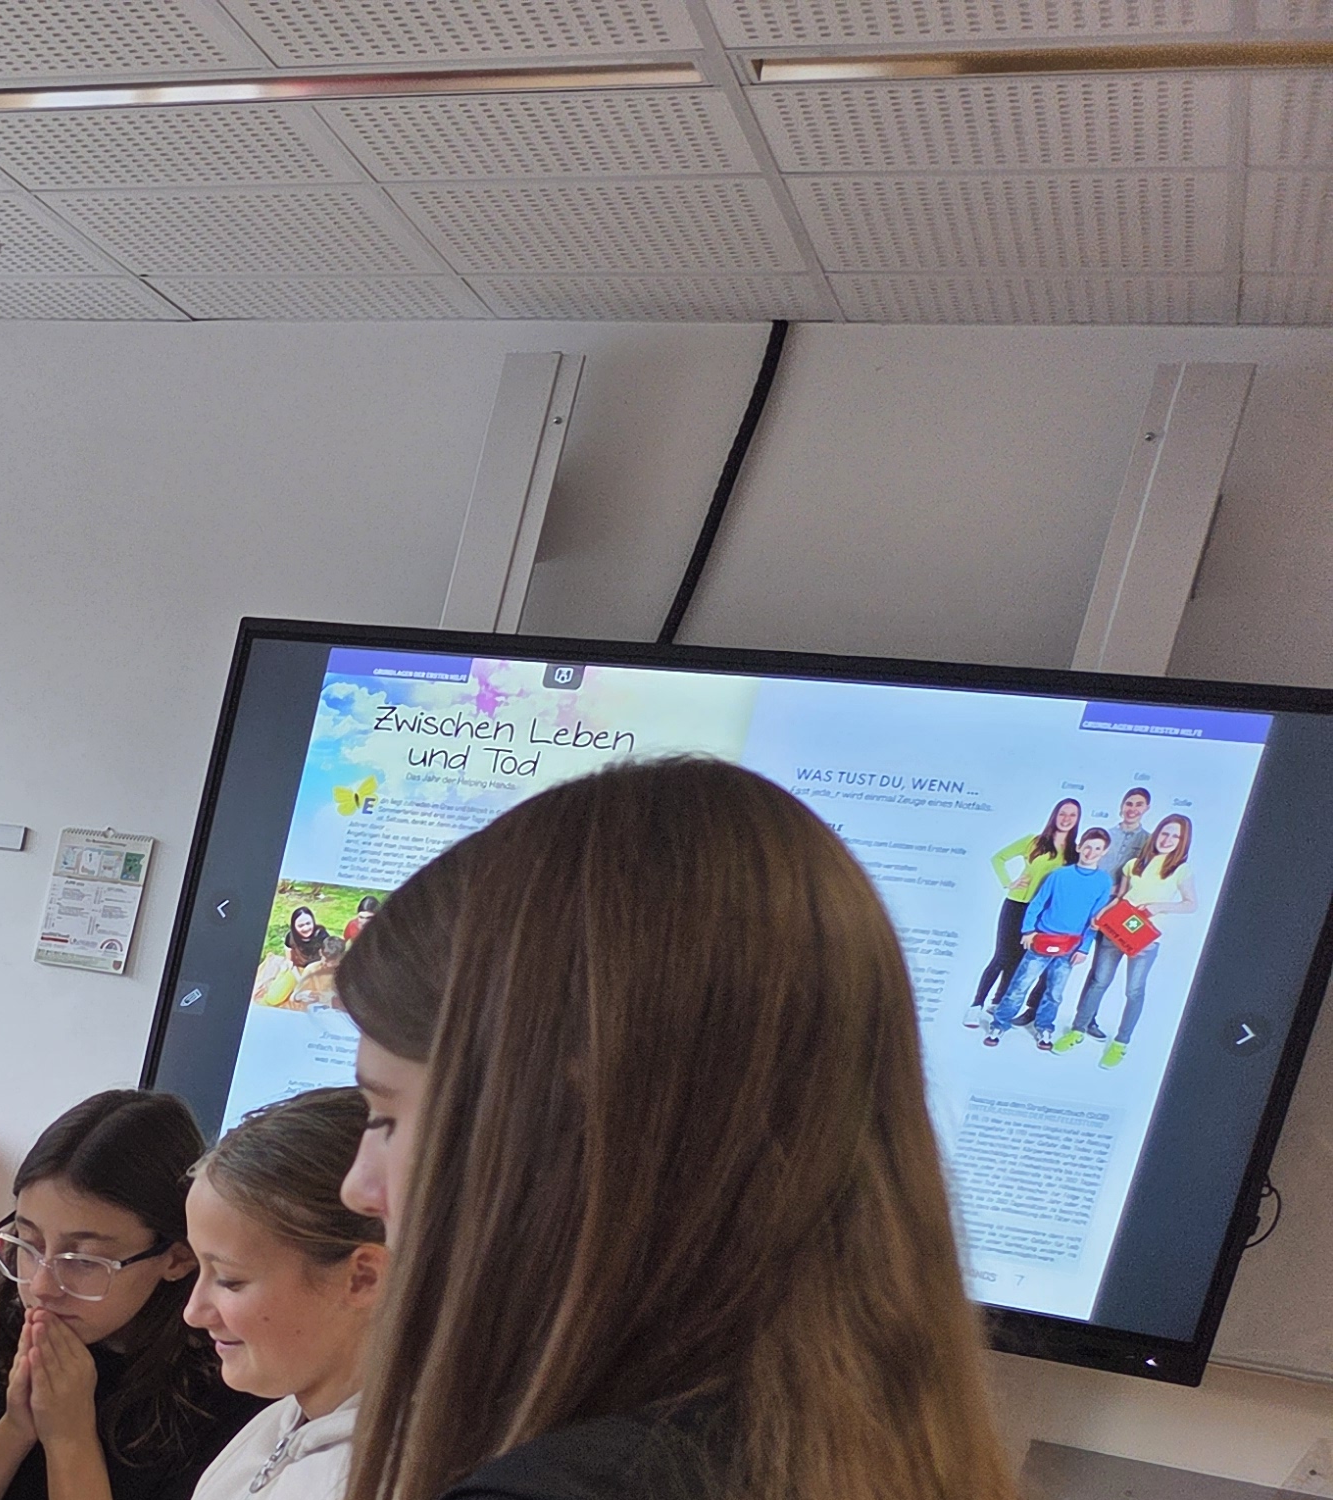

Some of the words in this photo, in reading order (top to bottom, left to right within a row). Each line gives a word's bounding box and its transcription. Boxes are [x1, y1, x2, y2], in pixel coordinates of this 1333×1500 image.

[373, 706, 515, 743] Zwischen
[529, 718, 635, 753] Leben
[407, 745, 471, 771] und
[483, 747, 541, 777] Tod
[406, 772, 421, 781] Das
[421, 774, 441, 783] Jahr
[441, 776, 457, 784] der
[457, 777, 487, 788] Helping
[796, 767, 834, 783] WAS
[837, 771, 877, 787] TUST
[879, 775, 906, 791] DU,
[911, 777, 965, 794] WENN
[841, 790, 864, 802] wird
